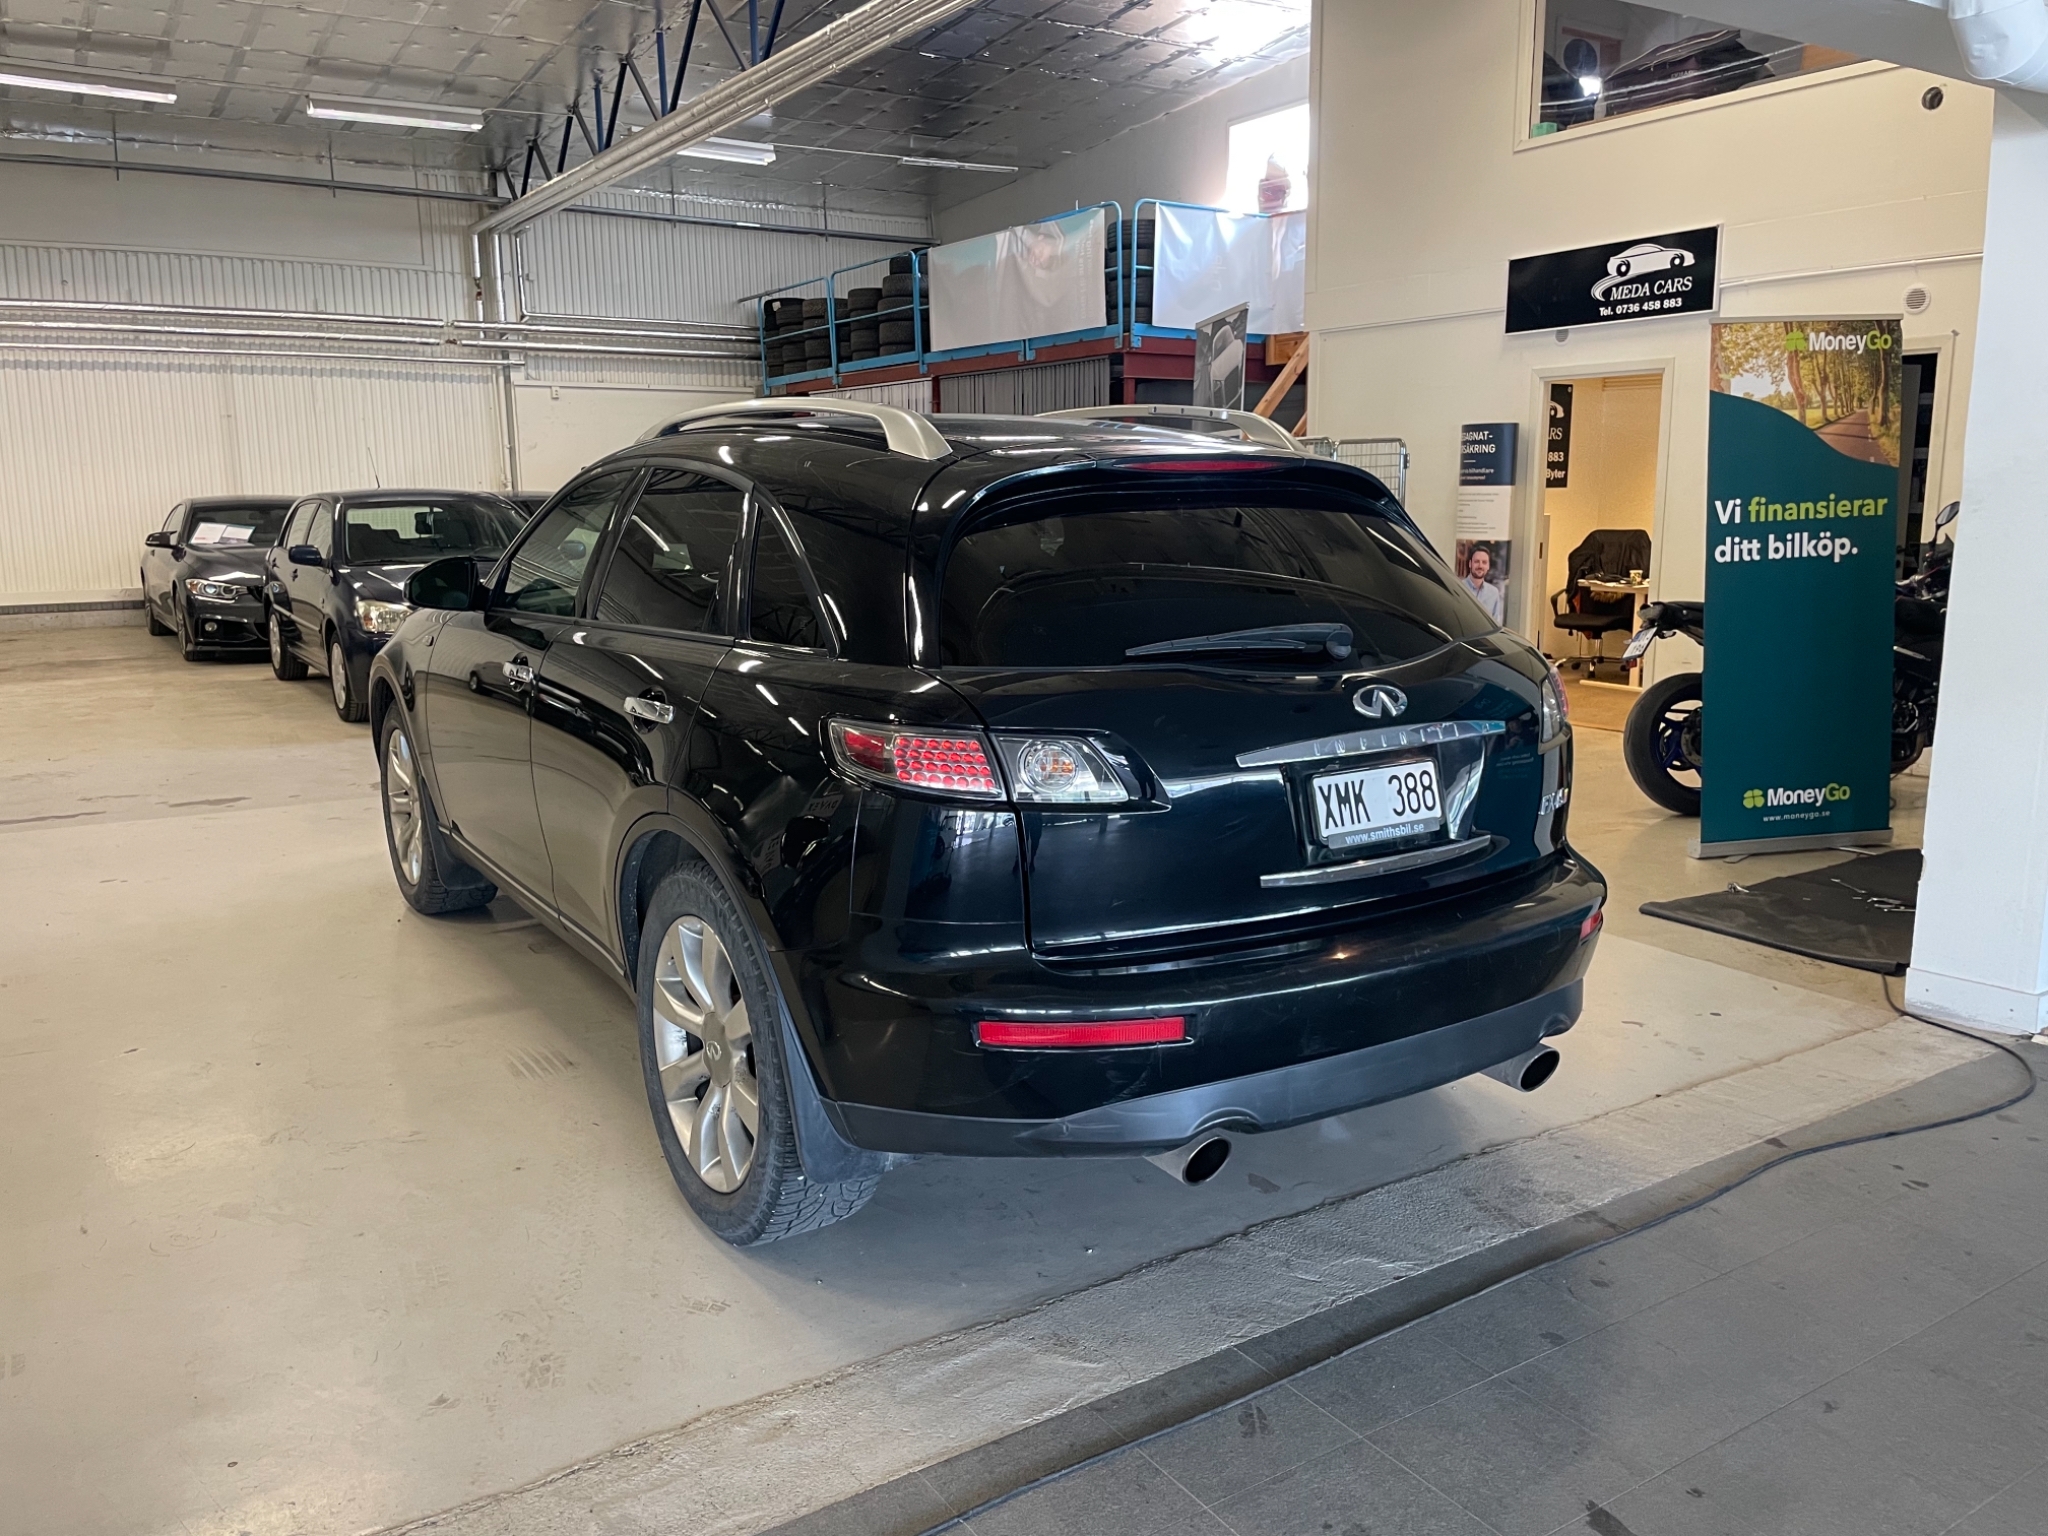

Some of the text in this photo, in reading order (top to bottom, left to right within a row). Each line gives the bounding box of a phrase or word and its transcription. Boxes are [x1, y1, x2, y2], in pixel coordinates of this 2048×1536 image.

[1610, 276, 1693, 301] MEDA CARS
[1599, 297, 1682, 316] Tel. 0736 458 883
[1809, 330, 1893, 354] MoneyGo
[1548, 427, 1563, 440] RS
[1547, 451, 1565, 462] 883
[1714, 493, 1888, 525] Vi finansierar
[1714, 531, 1859, 563] ditt bilköp.
[1318, 769, 1437, 829] XMK 388
[1767, 782, 1851, 807] MoneyGo
[1763, 810, 1831, 822] www.moneygo.se
[1345, 823, 1425, 845] www.smithsbil.se
